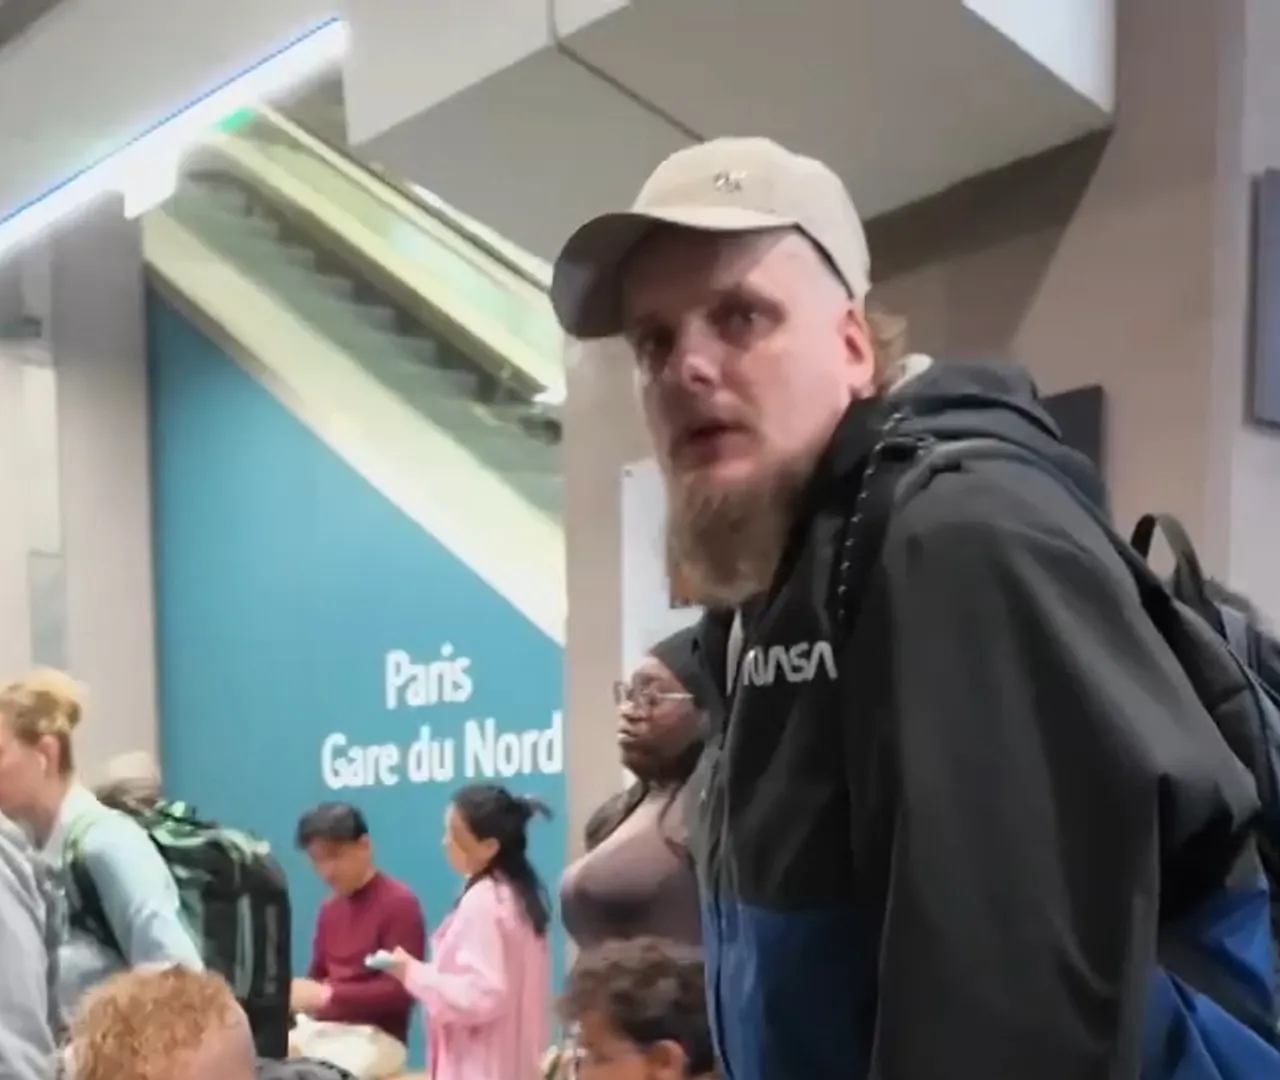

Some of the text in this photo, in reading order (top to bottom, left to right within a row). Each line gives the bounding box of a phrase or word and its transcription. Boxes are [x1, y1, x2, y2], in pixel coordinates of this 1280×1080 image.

[384, 640, 473, 710] Paris
[742, 640, 839, 687] NASA
[321, 709, 563, 790] Gare du Nord
